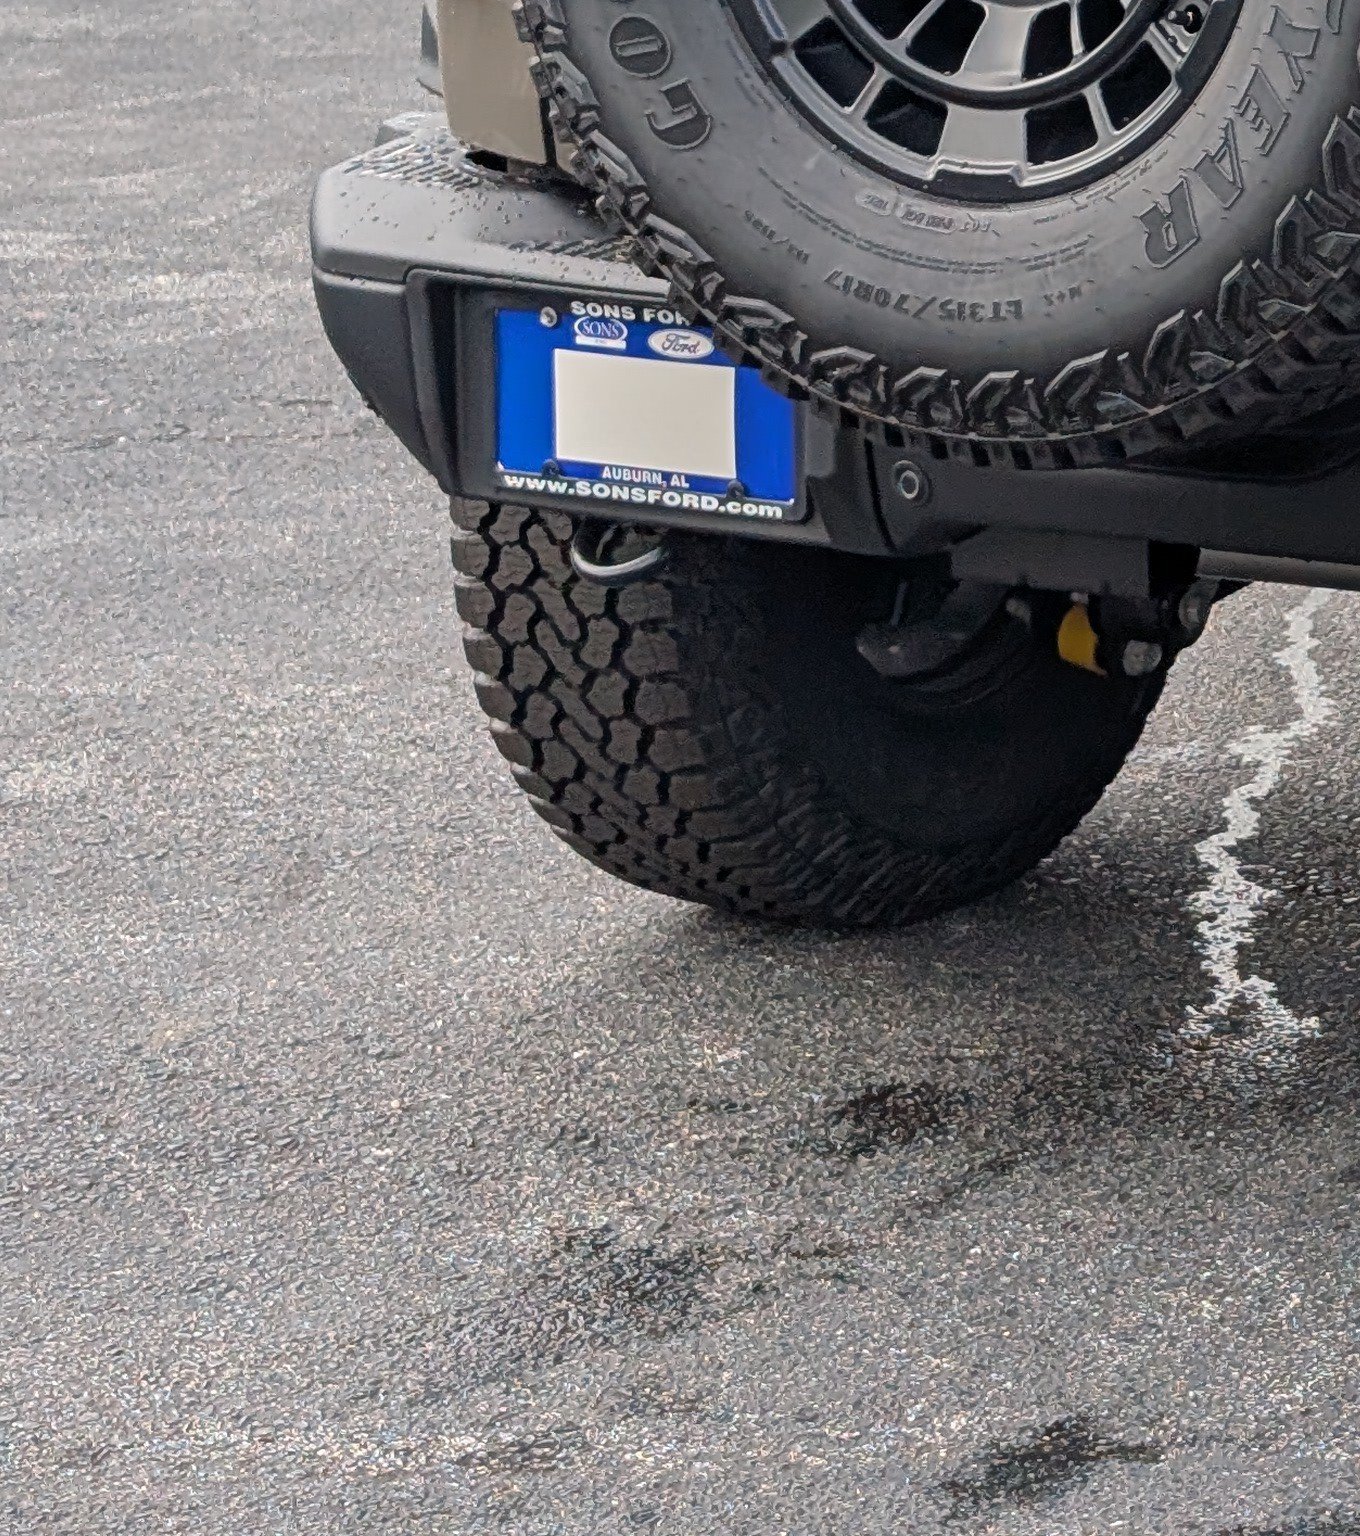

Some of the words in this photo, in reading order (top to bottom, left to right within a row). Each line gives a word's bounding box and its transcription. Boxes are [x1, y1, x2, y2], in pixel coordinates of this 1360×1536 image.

[570, 300, 637, 321] SONS
[581, 320, 620, 338] SONS
[661, 332, 702, 354] Ford
[601, 465, 668, 488] AUBURN,
[670, 472, 690, 488] AL
[503, 474, 783, 519] www.SONSFORD.com
